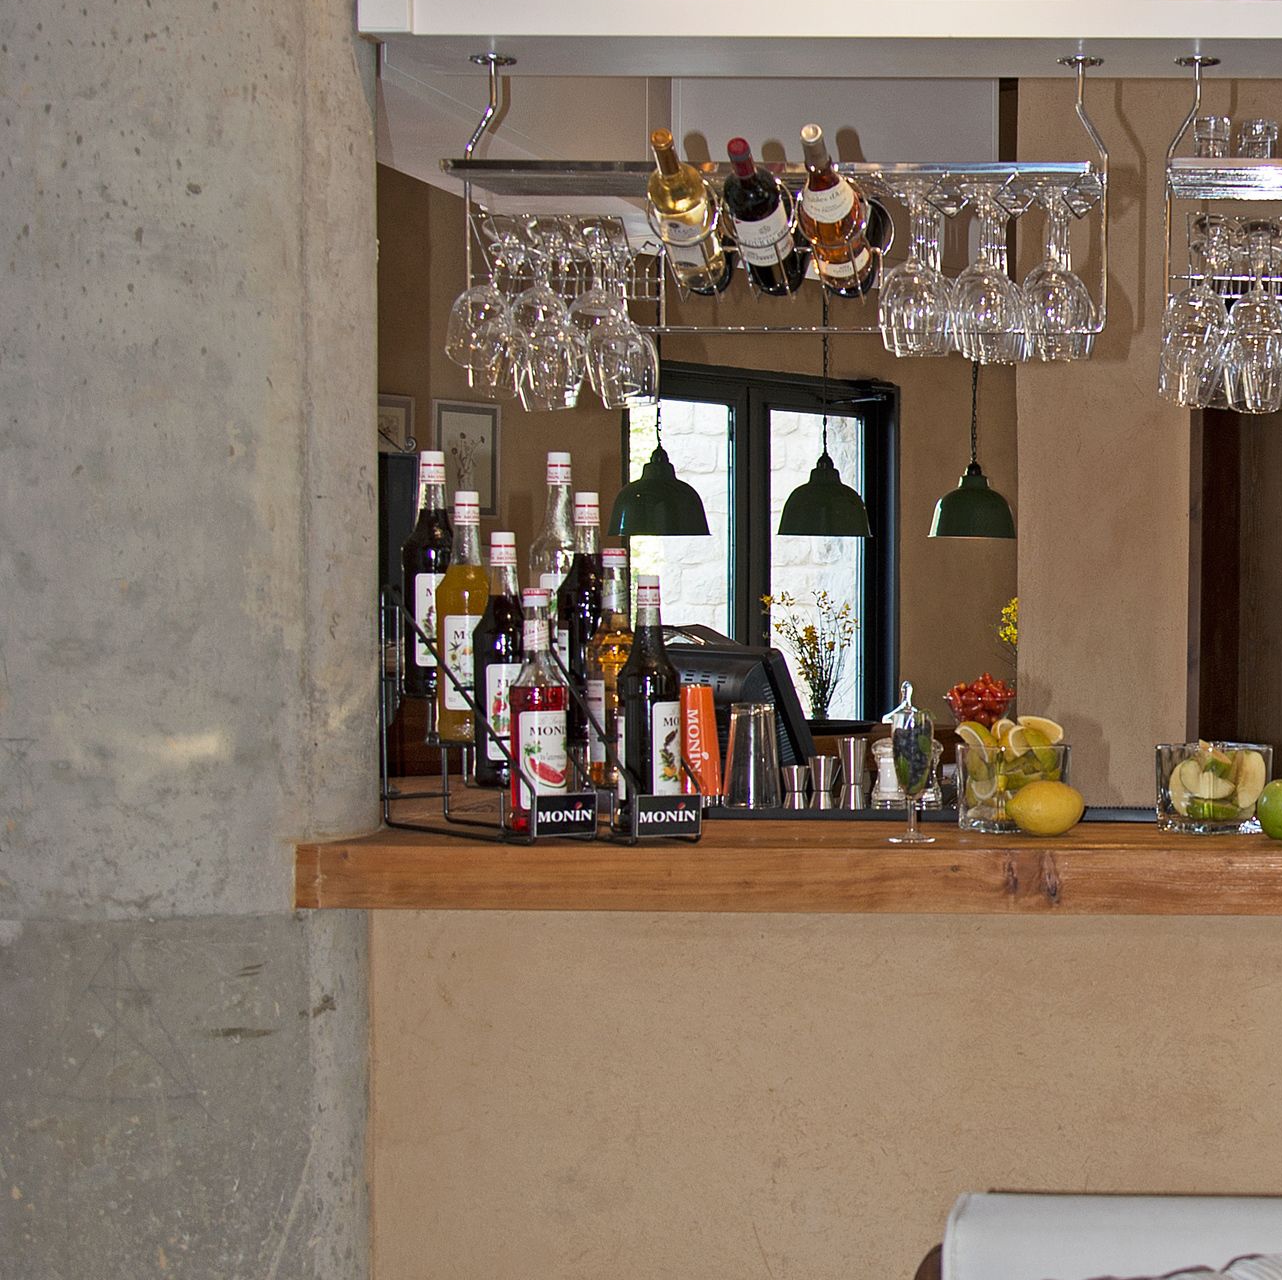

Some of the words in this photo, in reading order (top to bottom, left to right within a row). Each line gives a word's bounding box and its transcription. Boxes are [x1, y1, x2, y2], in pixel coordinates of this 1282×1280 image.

[529, 725, 567, 736] MONI
[687, 709, 703, 773] MONIN
[537, 807, 593, 824] MONIN
[639, 808, 697, 824] MONIN
